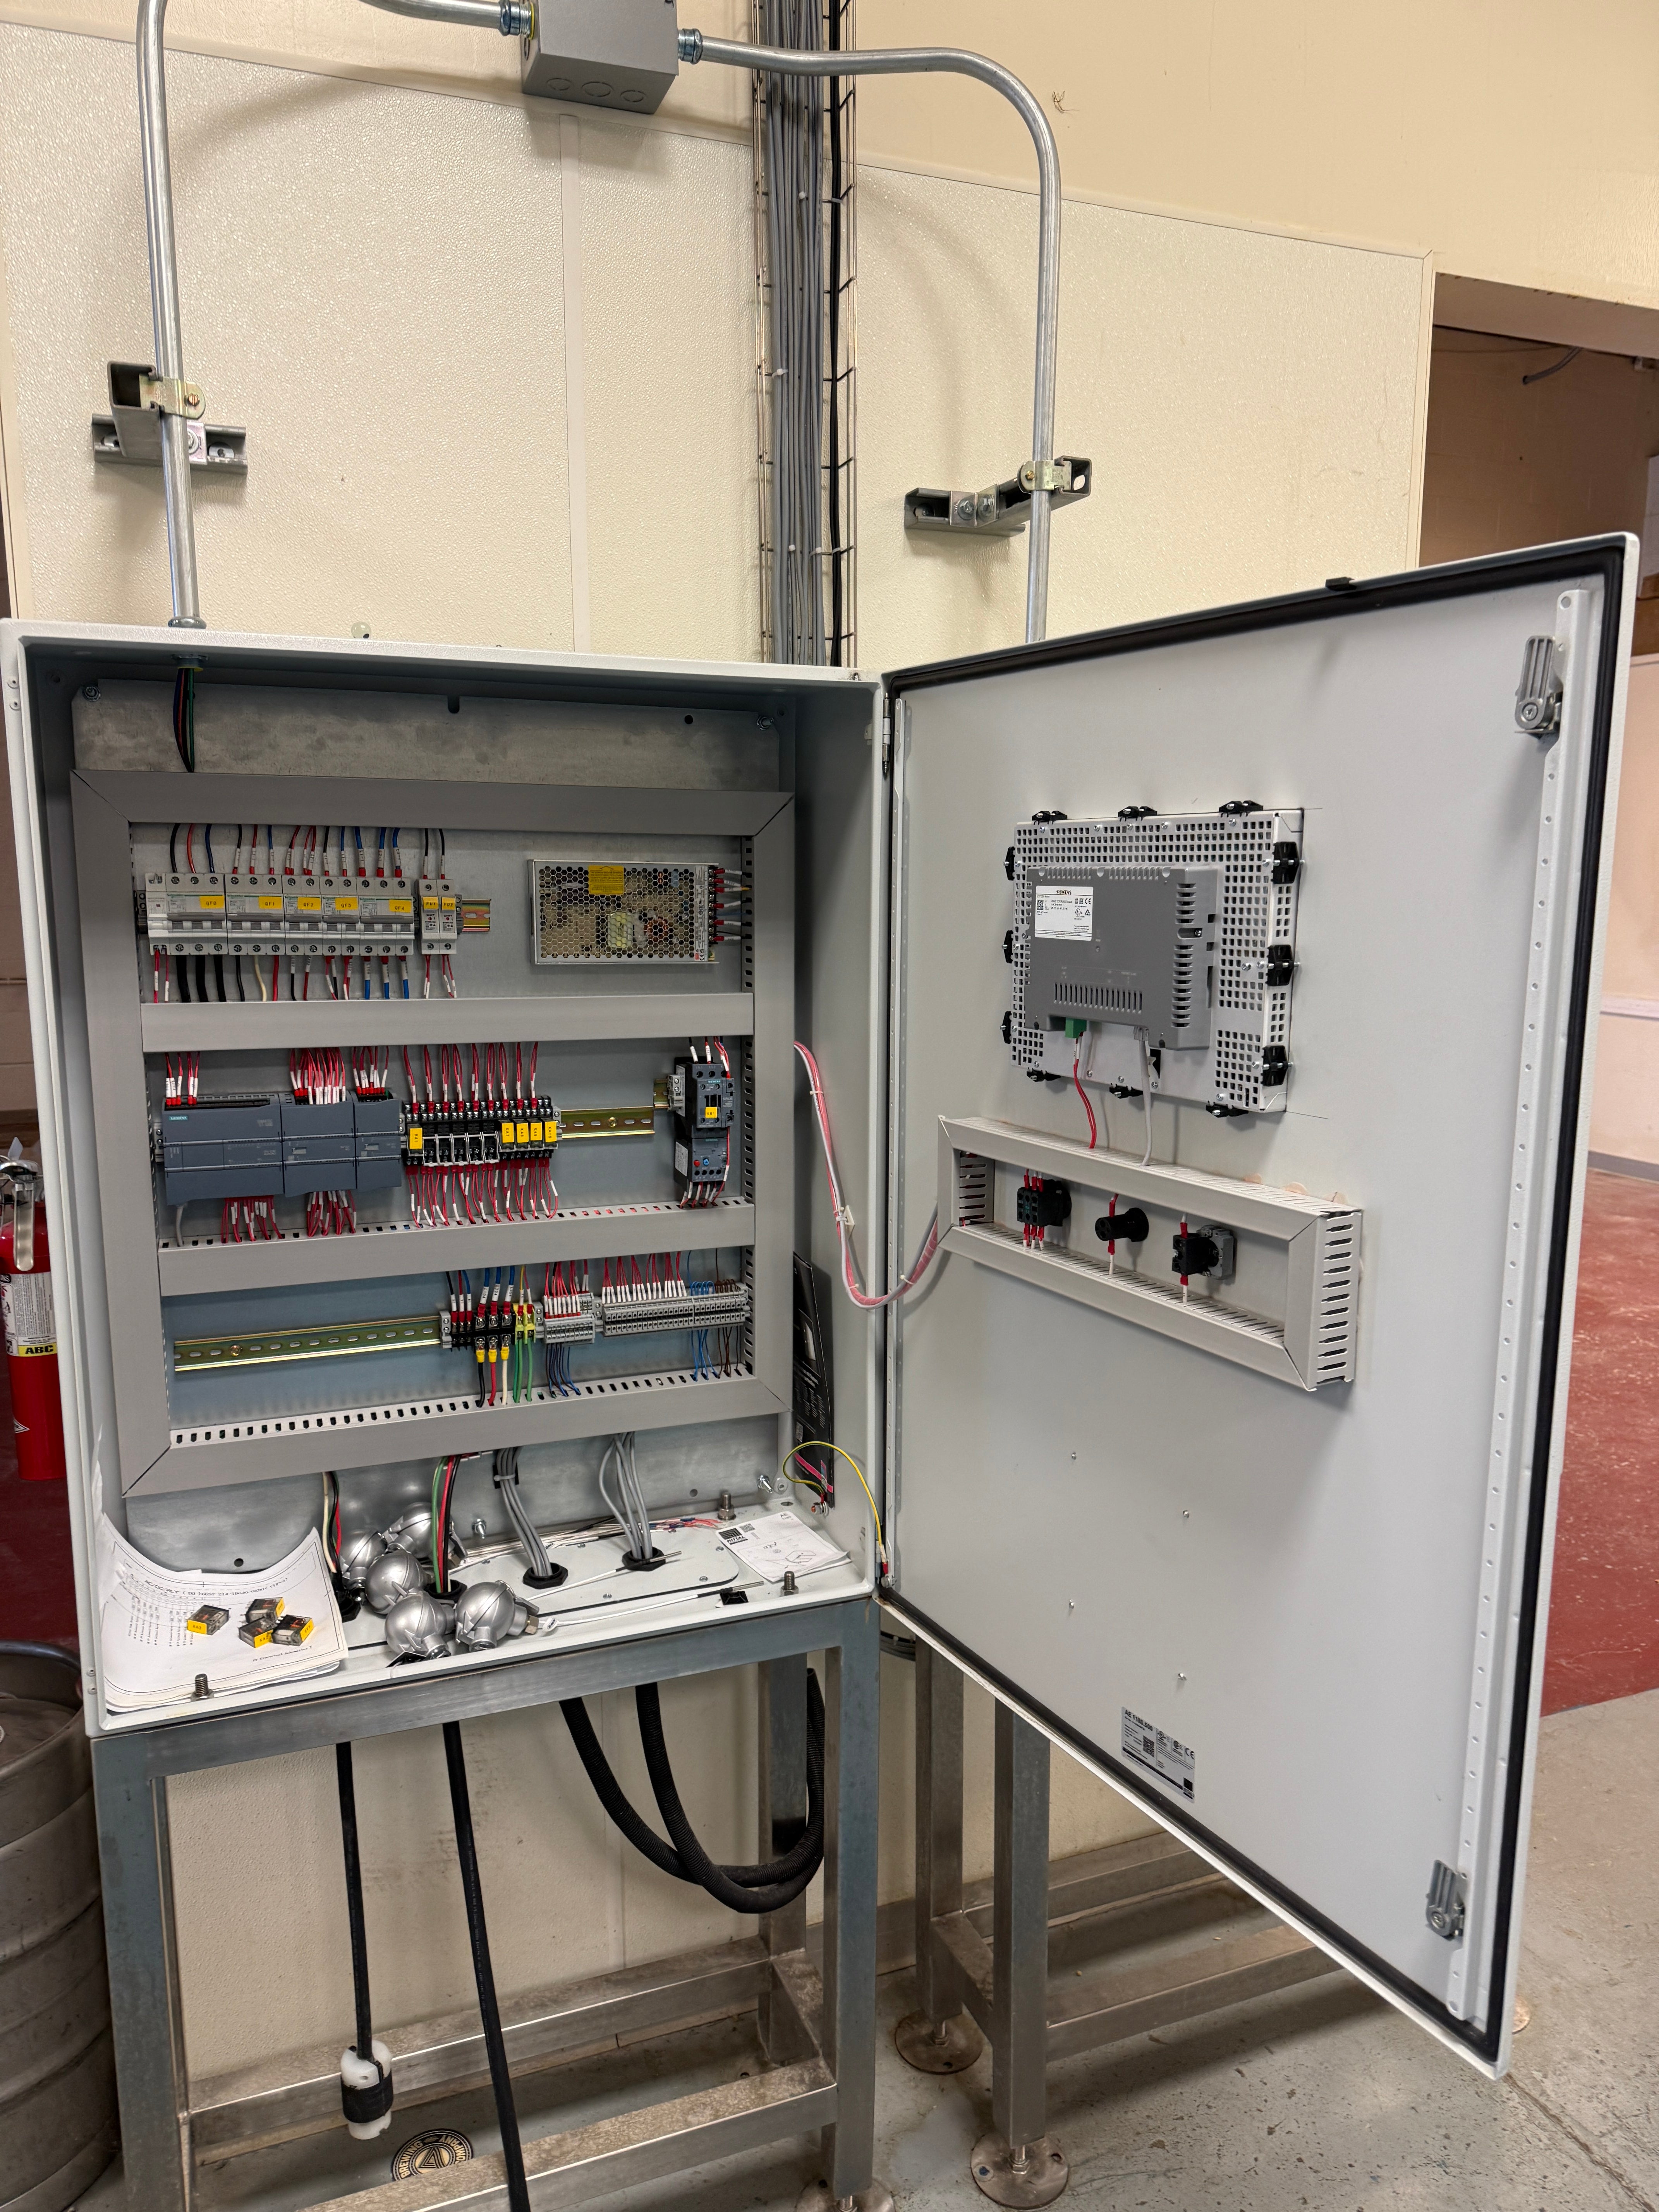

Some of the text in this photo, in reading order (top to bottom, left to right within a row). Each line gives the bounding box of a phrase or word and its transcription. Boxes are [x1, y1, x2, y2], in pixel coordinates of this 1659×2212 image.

[25, 1345, 53, 1355] ABC
[399, 2135, 466, 2179] BREWING OMPANY
